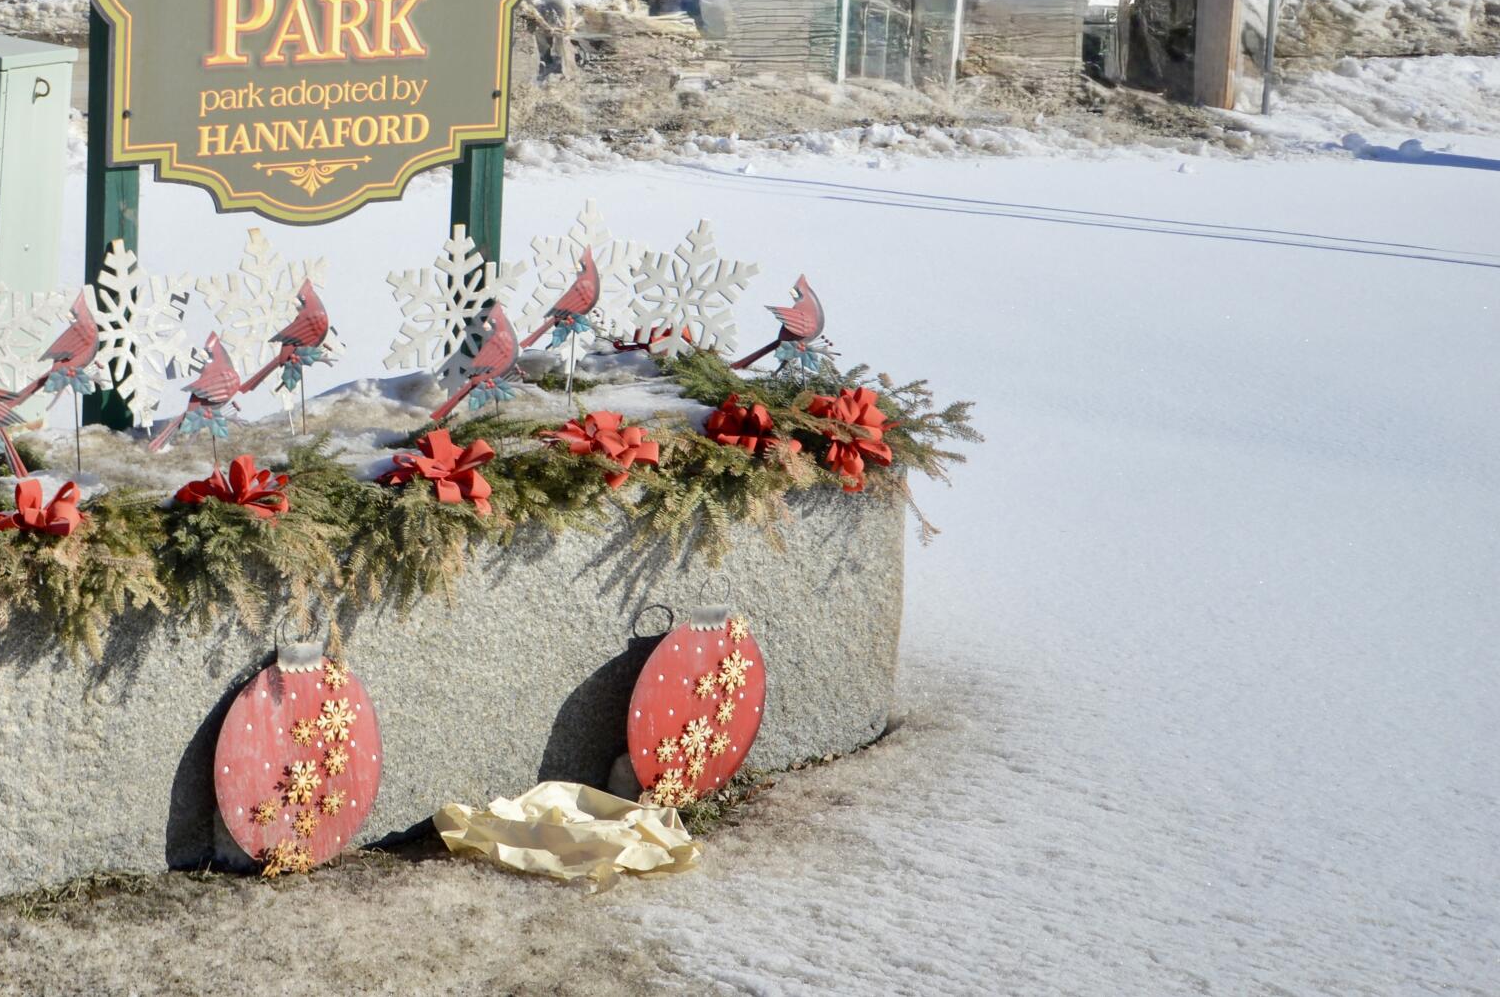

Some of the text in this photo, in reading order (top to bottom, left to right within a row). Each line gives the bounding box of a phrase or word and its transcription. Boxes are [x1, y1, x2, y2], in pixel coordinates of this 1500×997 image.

[198, 75, 428, 117] park adopted by
[196, 113, 430, 156] HANNAFORD
